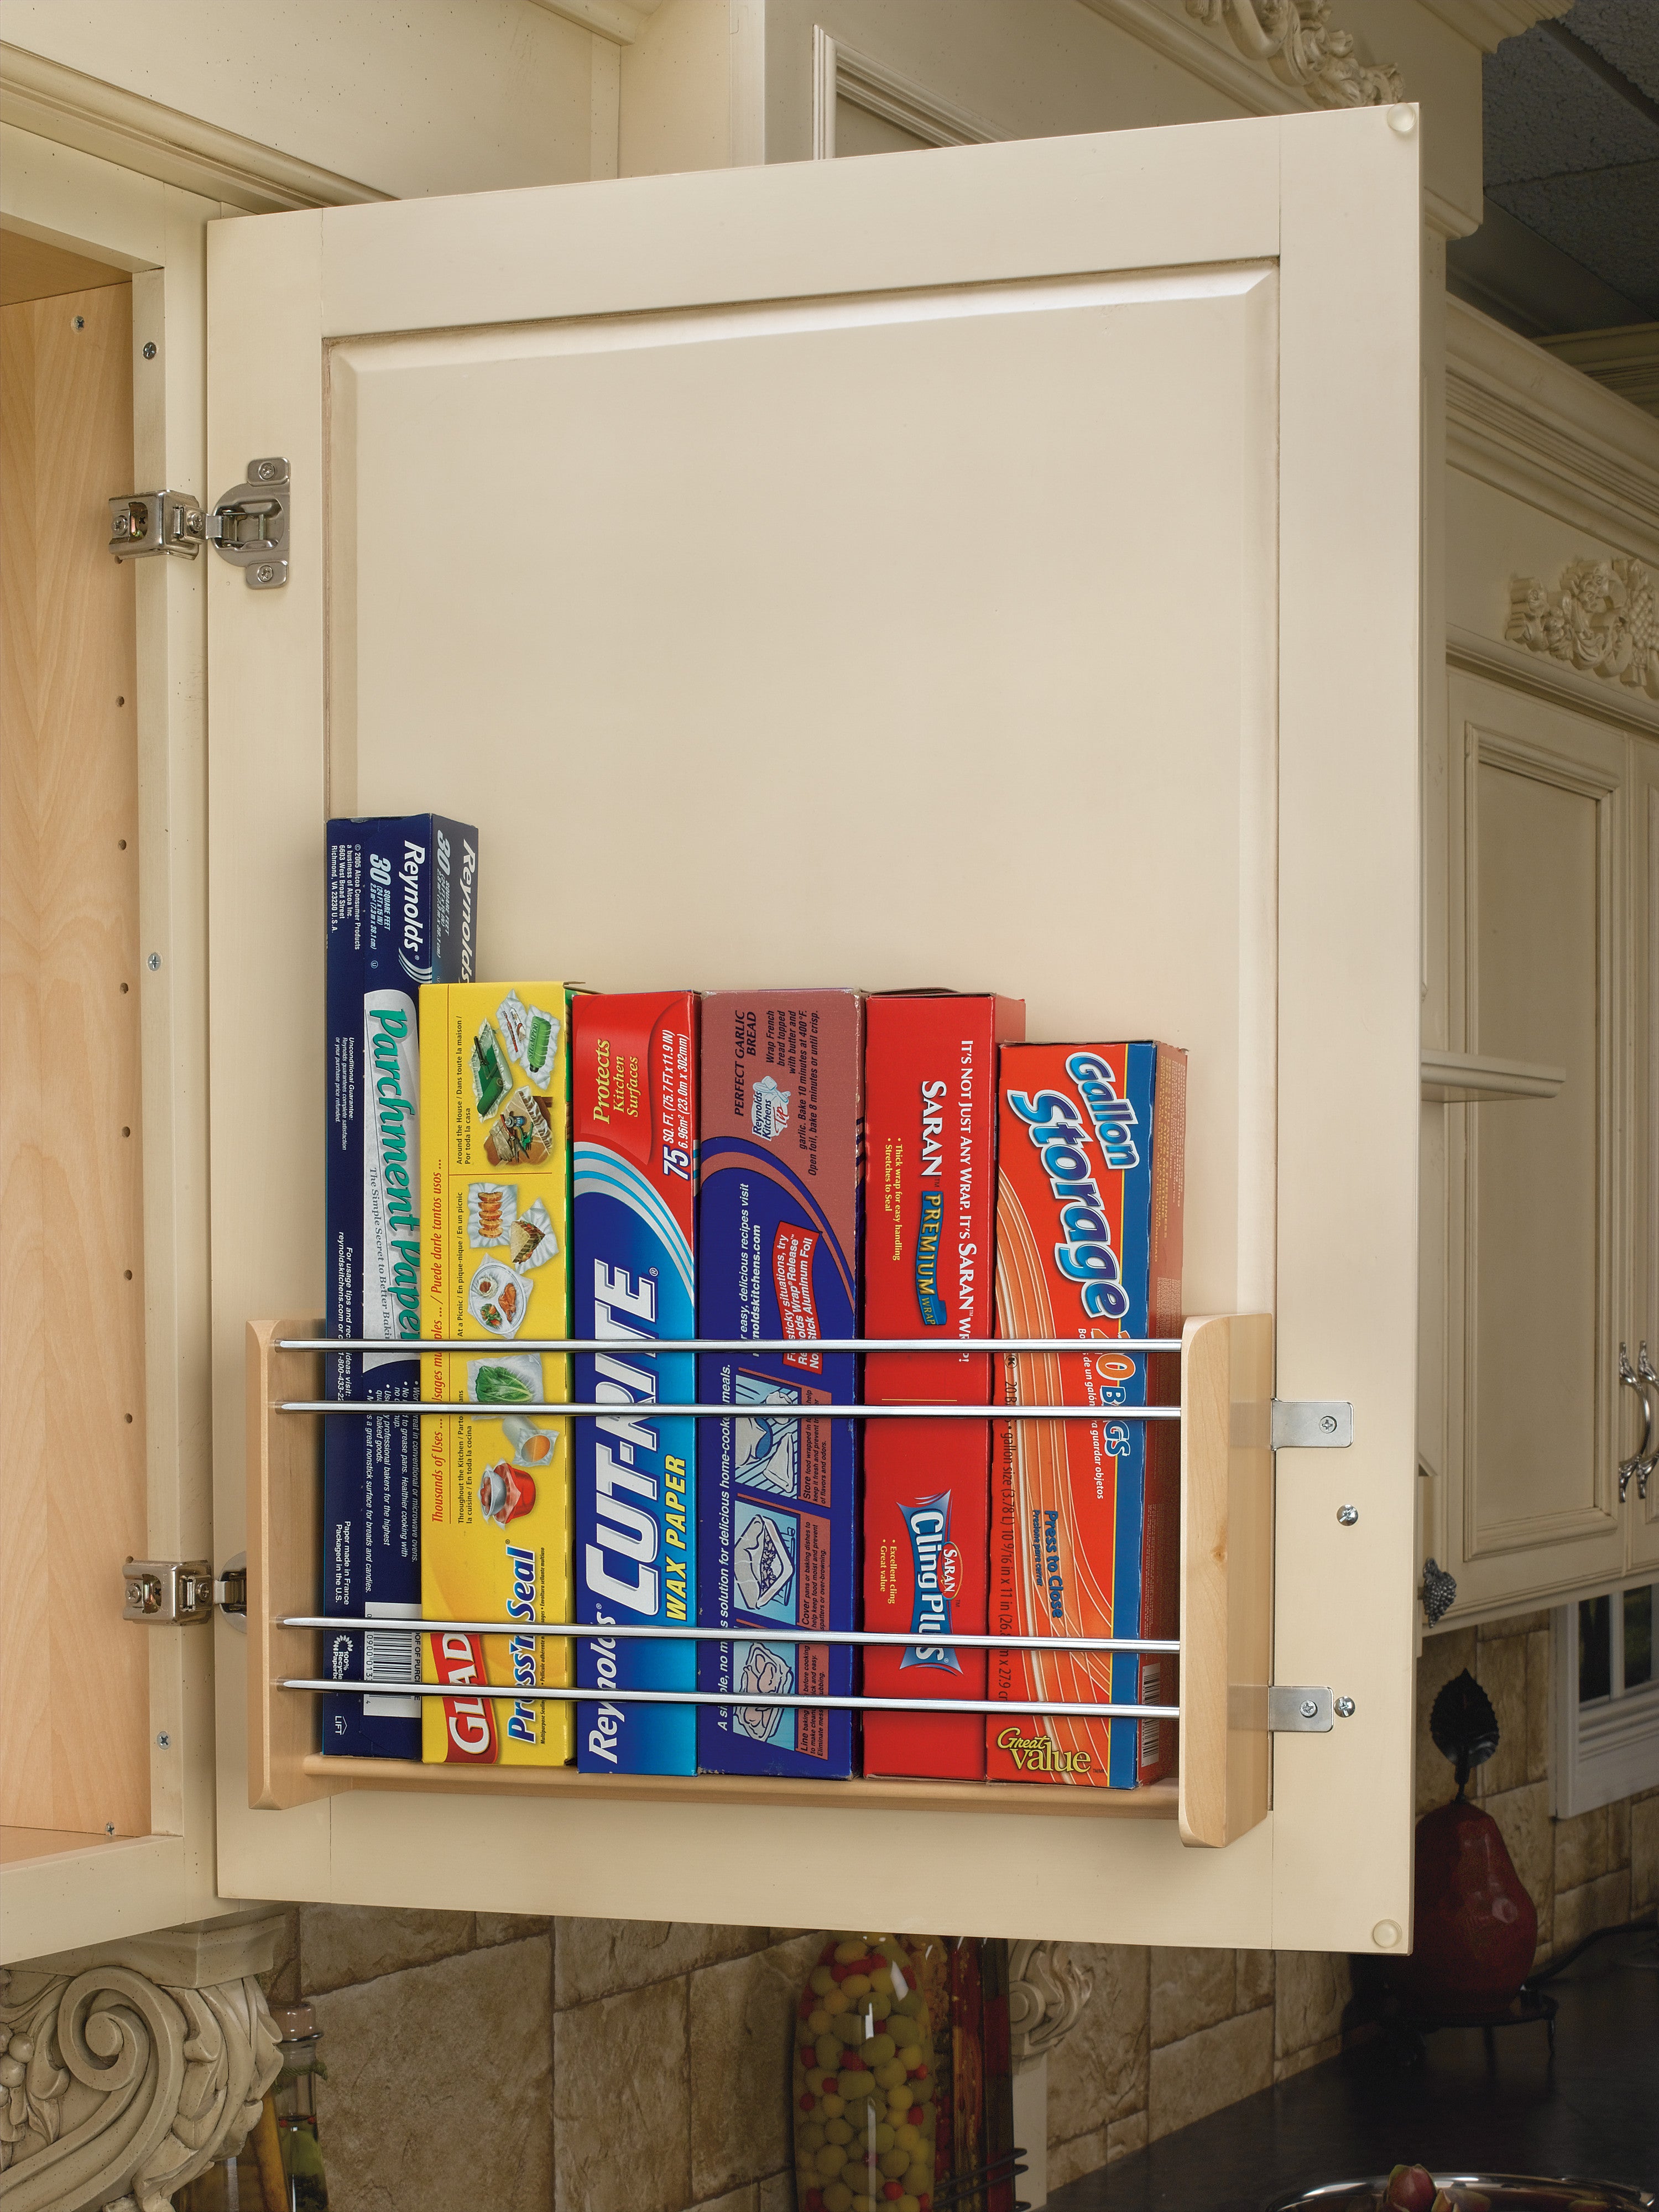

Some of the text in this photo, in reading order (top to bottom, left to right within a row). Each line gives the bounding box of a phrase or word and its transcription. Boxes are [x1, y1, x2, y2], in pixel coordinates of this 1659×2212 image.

[369, 853, 392, 886] 30
[437, 830, 451, 876] 30
[331, 880, 337, 890] VA
[746, 1011, 756, 1056] BREAD
[766, 1010, 776, 1063] Wrap French
[776, 1010, 787, 1066] bread topped
[787, 1010, 796, 1027] and
[787, 1027, 796, 1054] butter
[734, 1010, 744, 1117] PERFECT GARLIC
[961, 1040, 973, 1064] IT'S
[593, 1039, 609, 1124] Protects
[613, 1056, 624, 1113] Kitchen
[626, 1056, 641, 1117] Surfaces
[961, 1068, 973, 1099] NOT
[753, 1091, 763, 1135] Reynolds
[762, 1099, 771, 1140] Kitchens
[773, 1105, 790, 1134] Tip
[958, 1102, 972, 1133] JUST
[1068, 1054, 1138, 1167] Gallon
[664, 1146, 690, 1180] 75
[895, 1144, 903, 1166] Thick
[960, 1136, 972, 1165] ANY
[885, 1183, 891, 1192] to
[959, 1167, 972, 1210] WRAP.
[1009, 1092, 1128, 1316] Storage
[369, 1167, 389, 1312] The Simple Secret to Better
[430, 1172, 442, 1293] Puede darle tantos usos
[893, 1224, 902, 1260] handling
[917, 1193, 941, 1295] PREMIUM
[959, 1215, 971, 1239] IT'S
[337, 1232, 345, 1322] reynoldskitchens.com
[739, 1183, 750, 1335] easy, delicious recipes visit
[776, 1234, 790, 1306] situations, try
[799, 1238, 813, 1315] Aluminum Foil
[921, 1297, 936, 1325] WRAP
[1083, 1357, 1097, 1406] de un galón
[1100, 1385, 1131, 1457] BGS
[431, 1431, 446, 1522] Thousands of Uses
[1000, 1432, 1016, 1514] gallon size (3.78
[1089, 1430, 1104, 1499] guardar objetos
[335, 1524, 343, 1562] Packaged
[665, 1454, 686, 1621] WAX PAPER
[718, 1490, 729, 1618] solution for delicious
[911, 1510, 944, 1589] Cling
[1032, 1509, 1043, 1587] Presione para cerrar
[943, 1548, 957, 1593] SARAN
[1044, 1510, 1063, 1618] Press to Close
[887, 1584, 897, 1604] cling
[442, 1632, 491, 1754] GLAD
[997, 1727, 1052, 1749] Great
